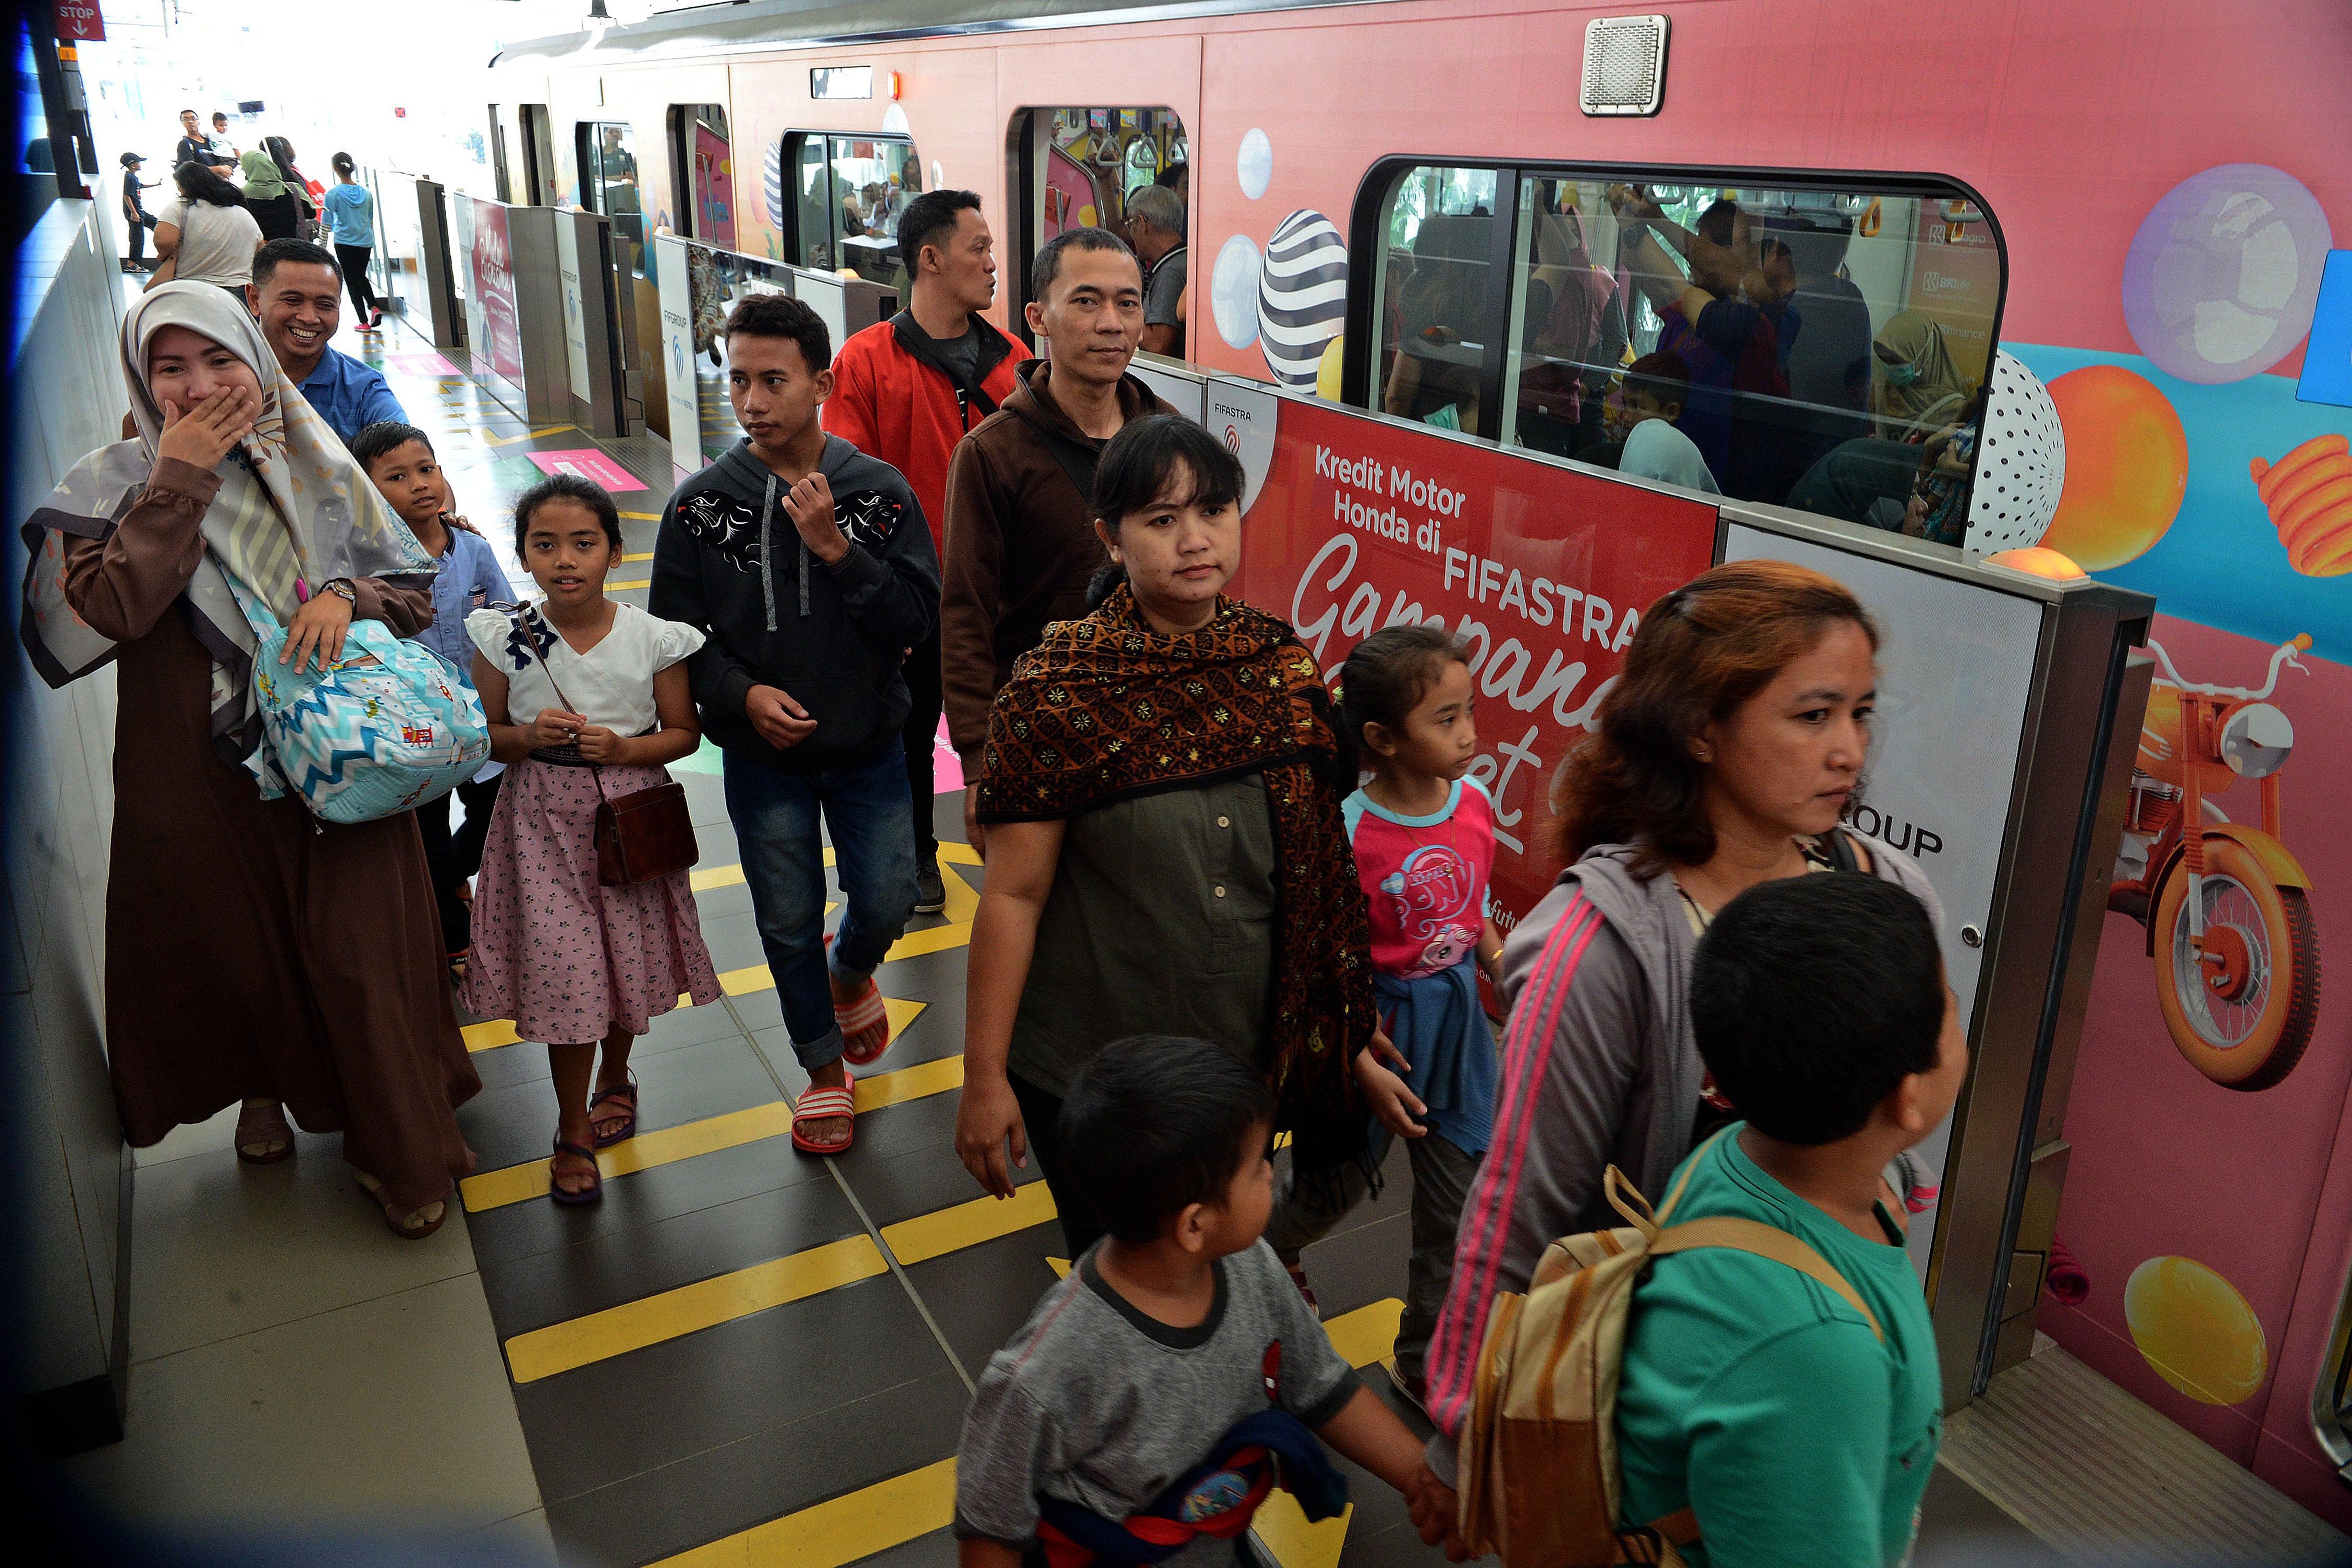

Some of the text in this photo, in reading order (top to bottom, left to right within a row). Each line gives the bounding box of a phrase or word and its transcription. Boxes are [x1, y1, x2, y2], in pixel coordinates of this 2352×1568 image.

[59, 6, 94, 19] STOP
[1215, 402, 1251, 422] FIFASTRA
[1315, 444, 1466, 518] Kredit Motor
[1334, 489, 1441, 555] Honda di
[1444, 546, 1640, 653] FIFASTRA
[1846, 805, 1943, 858] OUP
